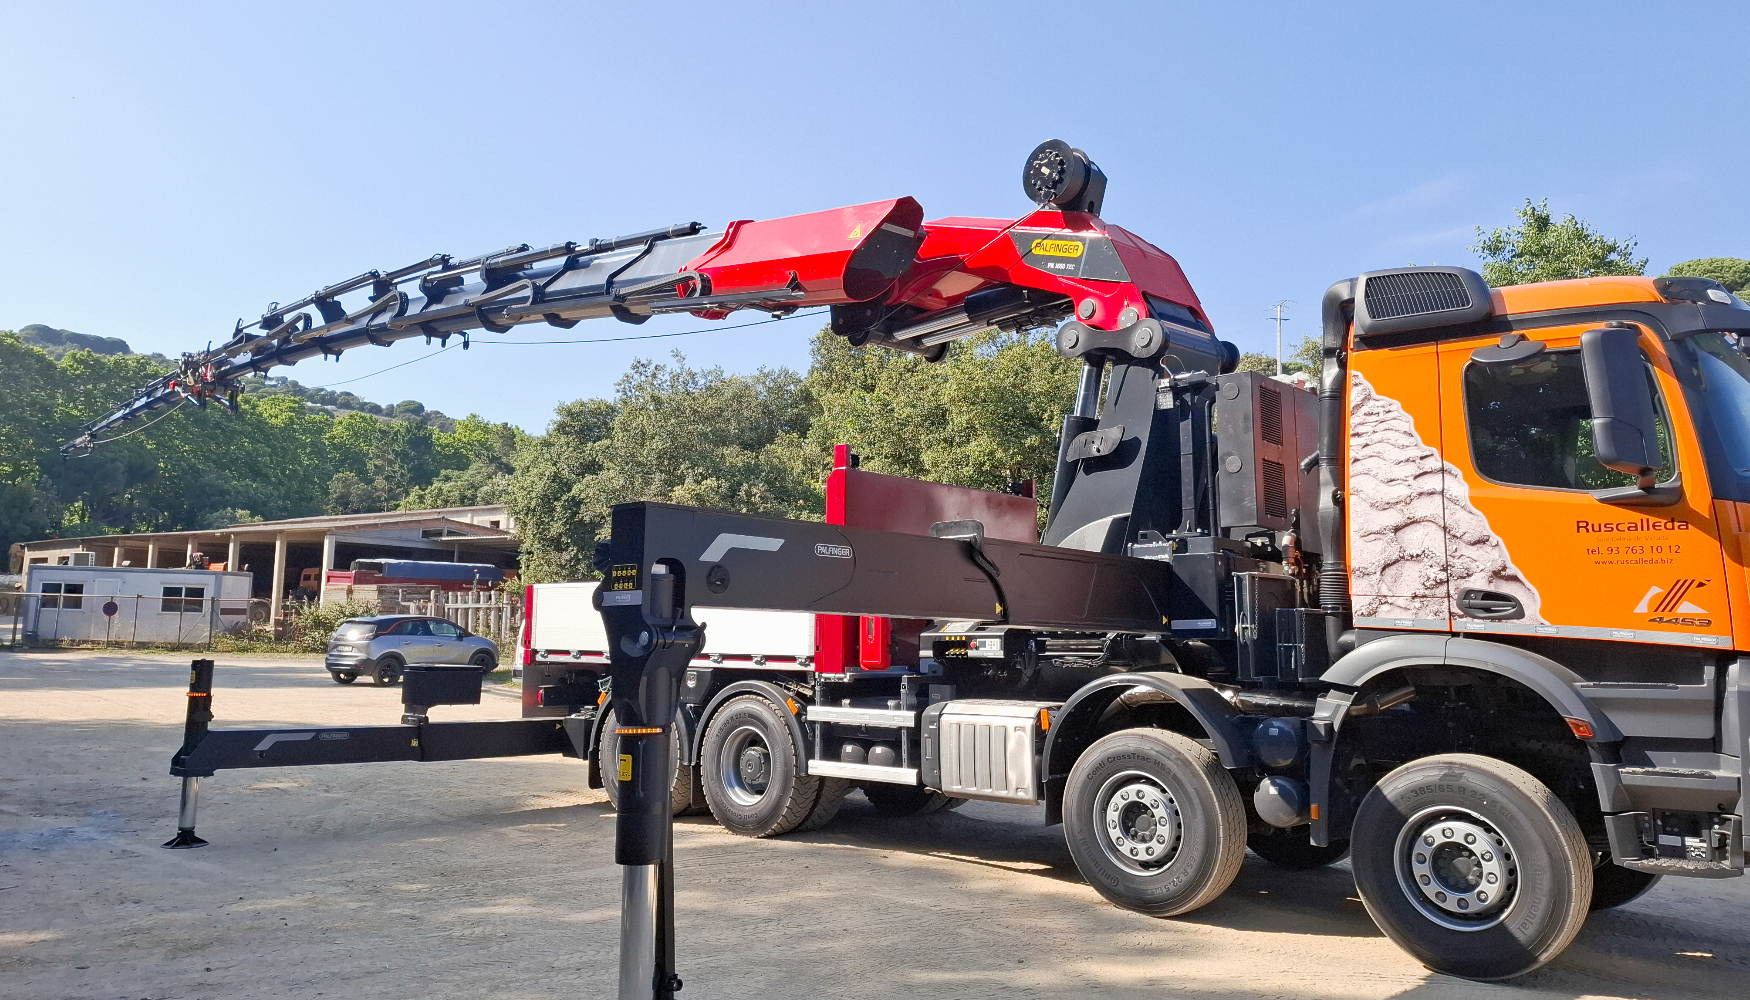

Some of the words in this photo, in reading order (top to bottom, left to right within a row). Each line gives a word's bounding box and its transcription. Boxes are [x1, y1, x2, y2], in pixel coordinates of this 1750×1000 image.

[1034, 242, 1080, 254] PALFINGER
[1576, 517, 1690, 534] Ruscalleda
[817, 545, 849, 556] PALFINGER
[1587, 546, 1604, 555] tel.
[1606, 546, 1620, 555] 93
[1624, 545, 1645, 555] 763
[1650, 545, 1663, 554] 10
[1668, 544, 1681, 554] 12
[1594, 557, 1674, 565] www.ruscalleda.biz
[1648, 616, 1713, 627] 4453
[1086, 760, 1106, 780] Conti
[1106, 752, 1151, 764] CrossTrac
[1410, 784, 1454, 798] 385/65
[1457, 786, 1466, 796] R
